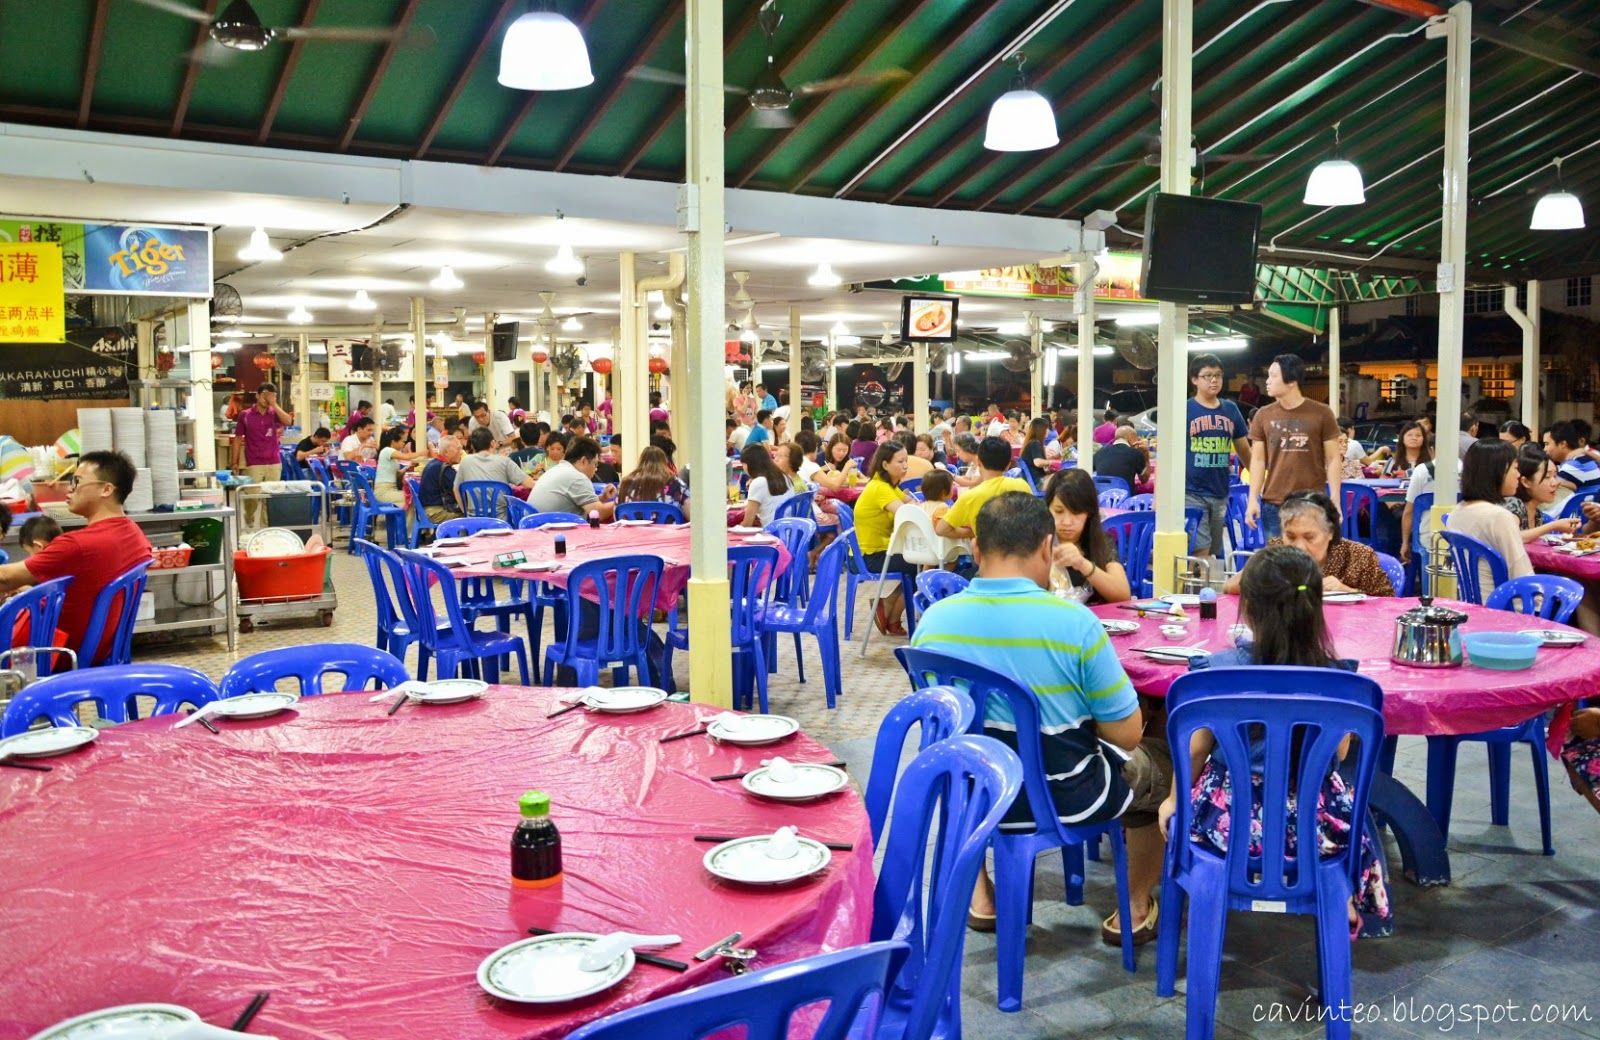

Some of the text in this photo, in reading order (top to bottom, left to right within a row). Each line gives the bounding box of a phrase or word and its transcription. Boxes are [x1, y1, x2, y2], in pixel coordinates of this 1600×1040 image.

[0, 252, 39, 283] 薄
[109, 238, 186, 278] Tiger
[91, 335, 138, 352] Asahi
